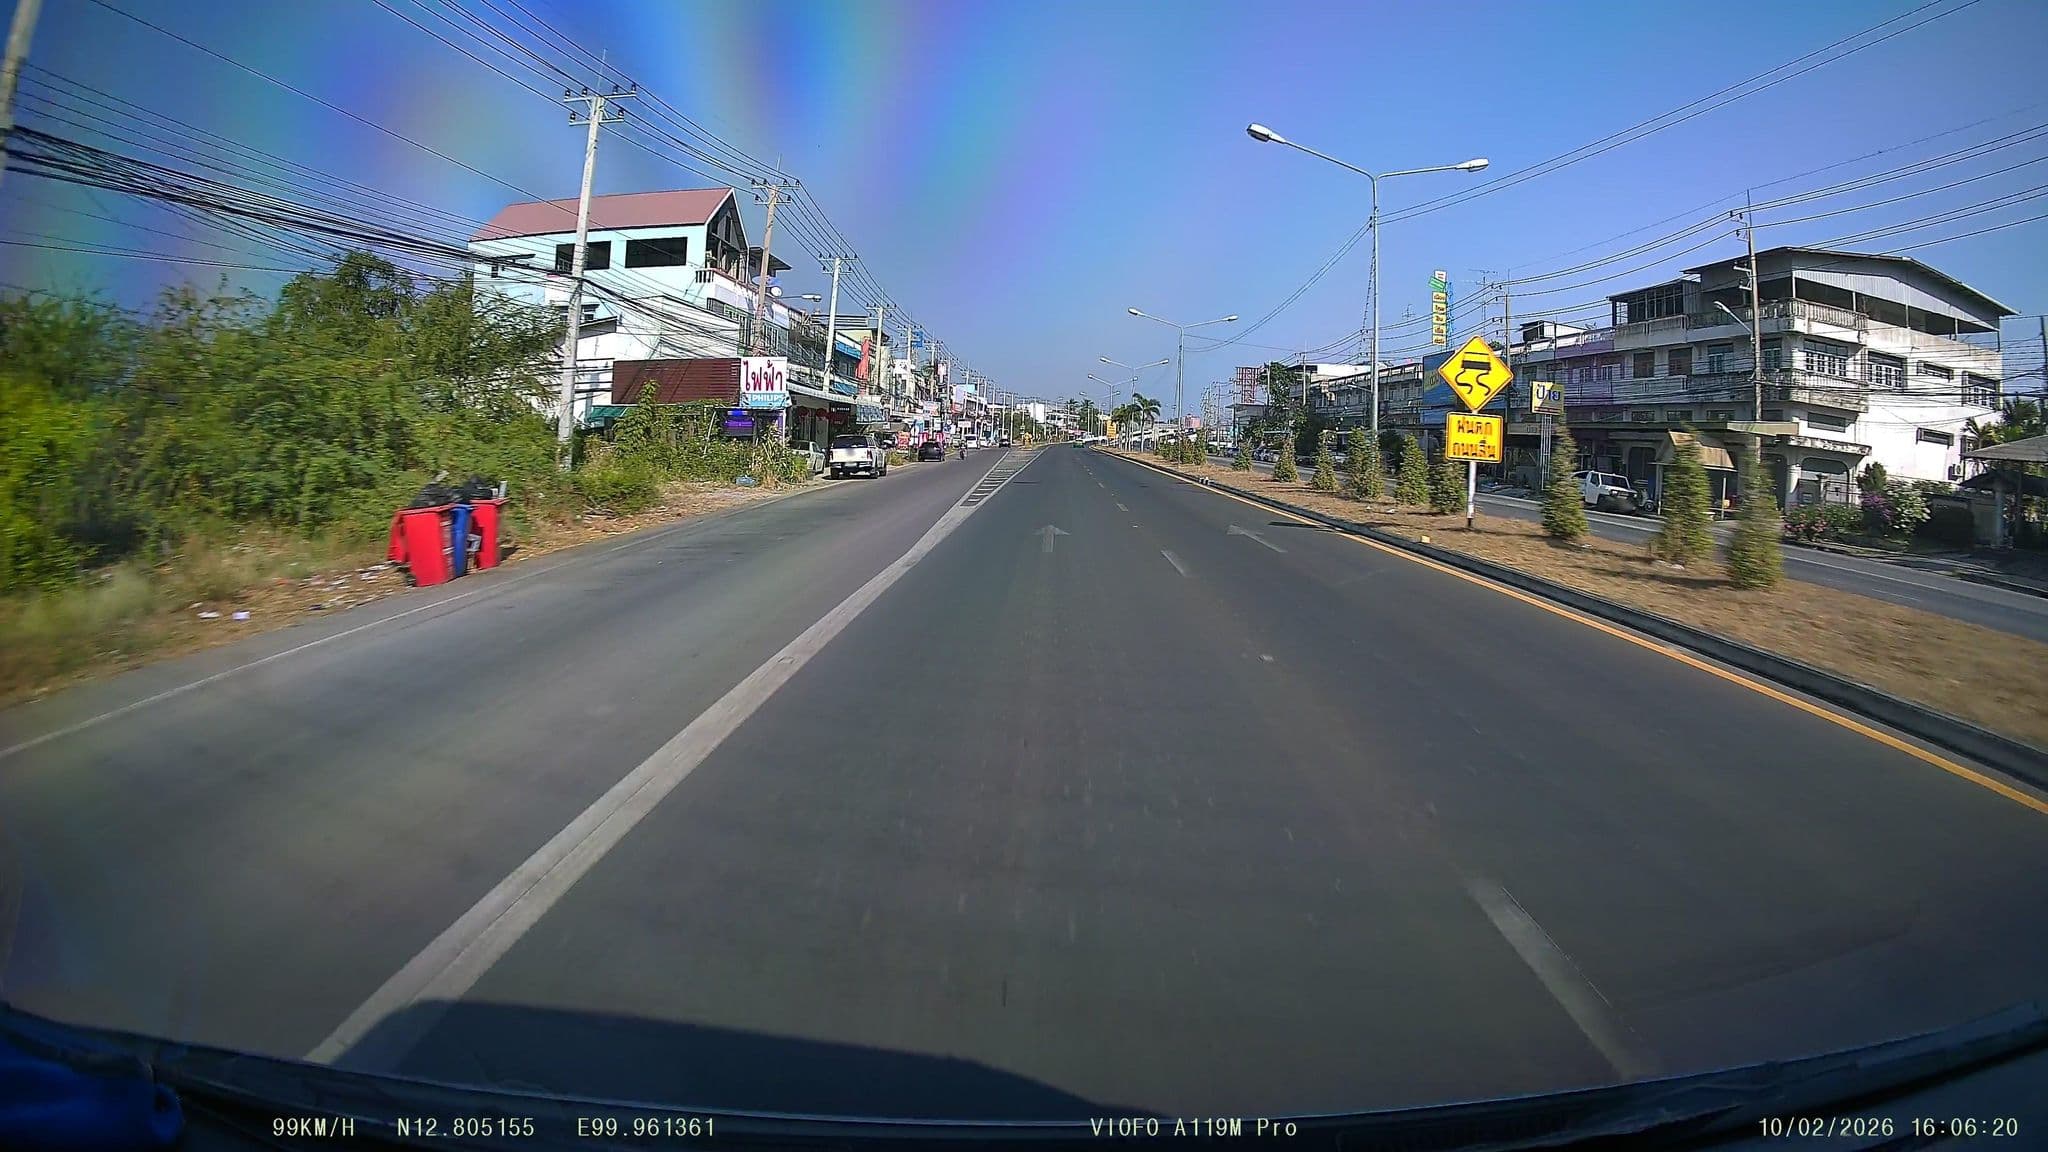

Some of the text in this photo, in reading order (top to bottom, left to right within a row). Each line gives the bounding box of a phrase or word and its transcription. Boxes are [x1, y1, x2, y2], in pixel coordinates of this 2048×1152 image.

[742, 359, 783, 392] ไฟฟ้า
[1457, 417, 1493, 435] ฝนตก
[1452, 437, 1496, 459] ถนนลื่น
